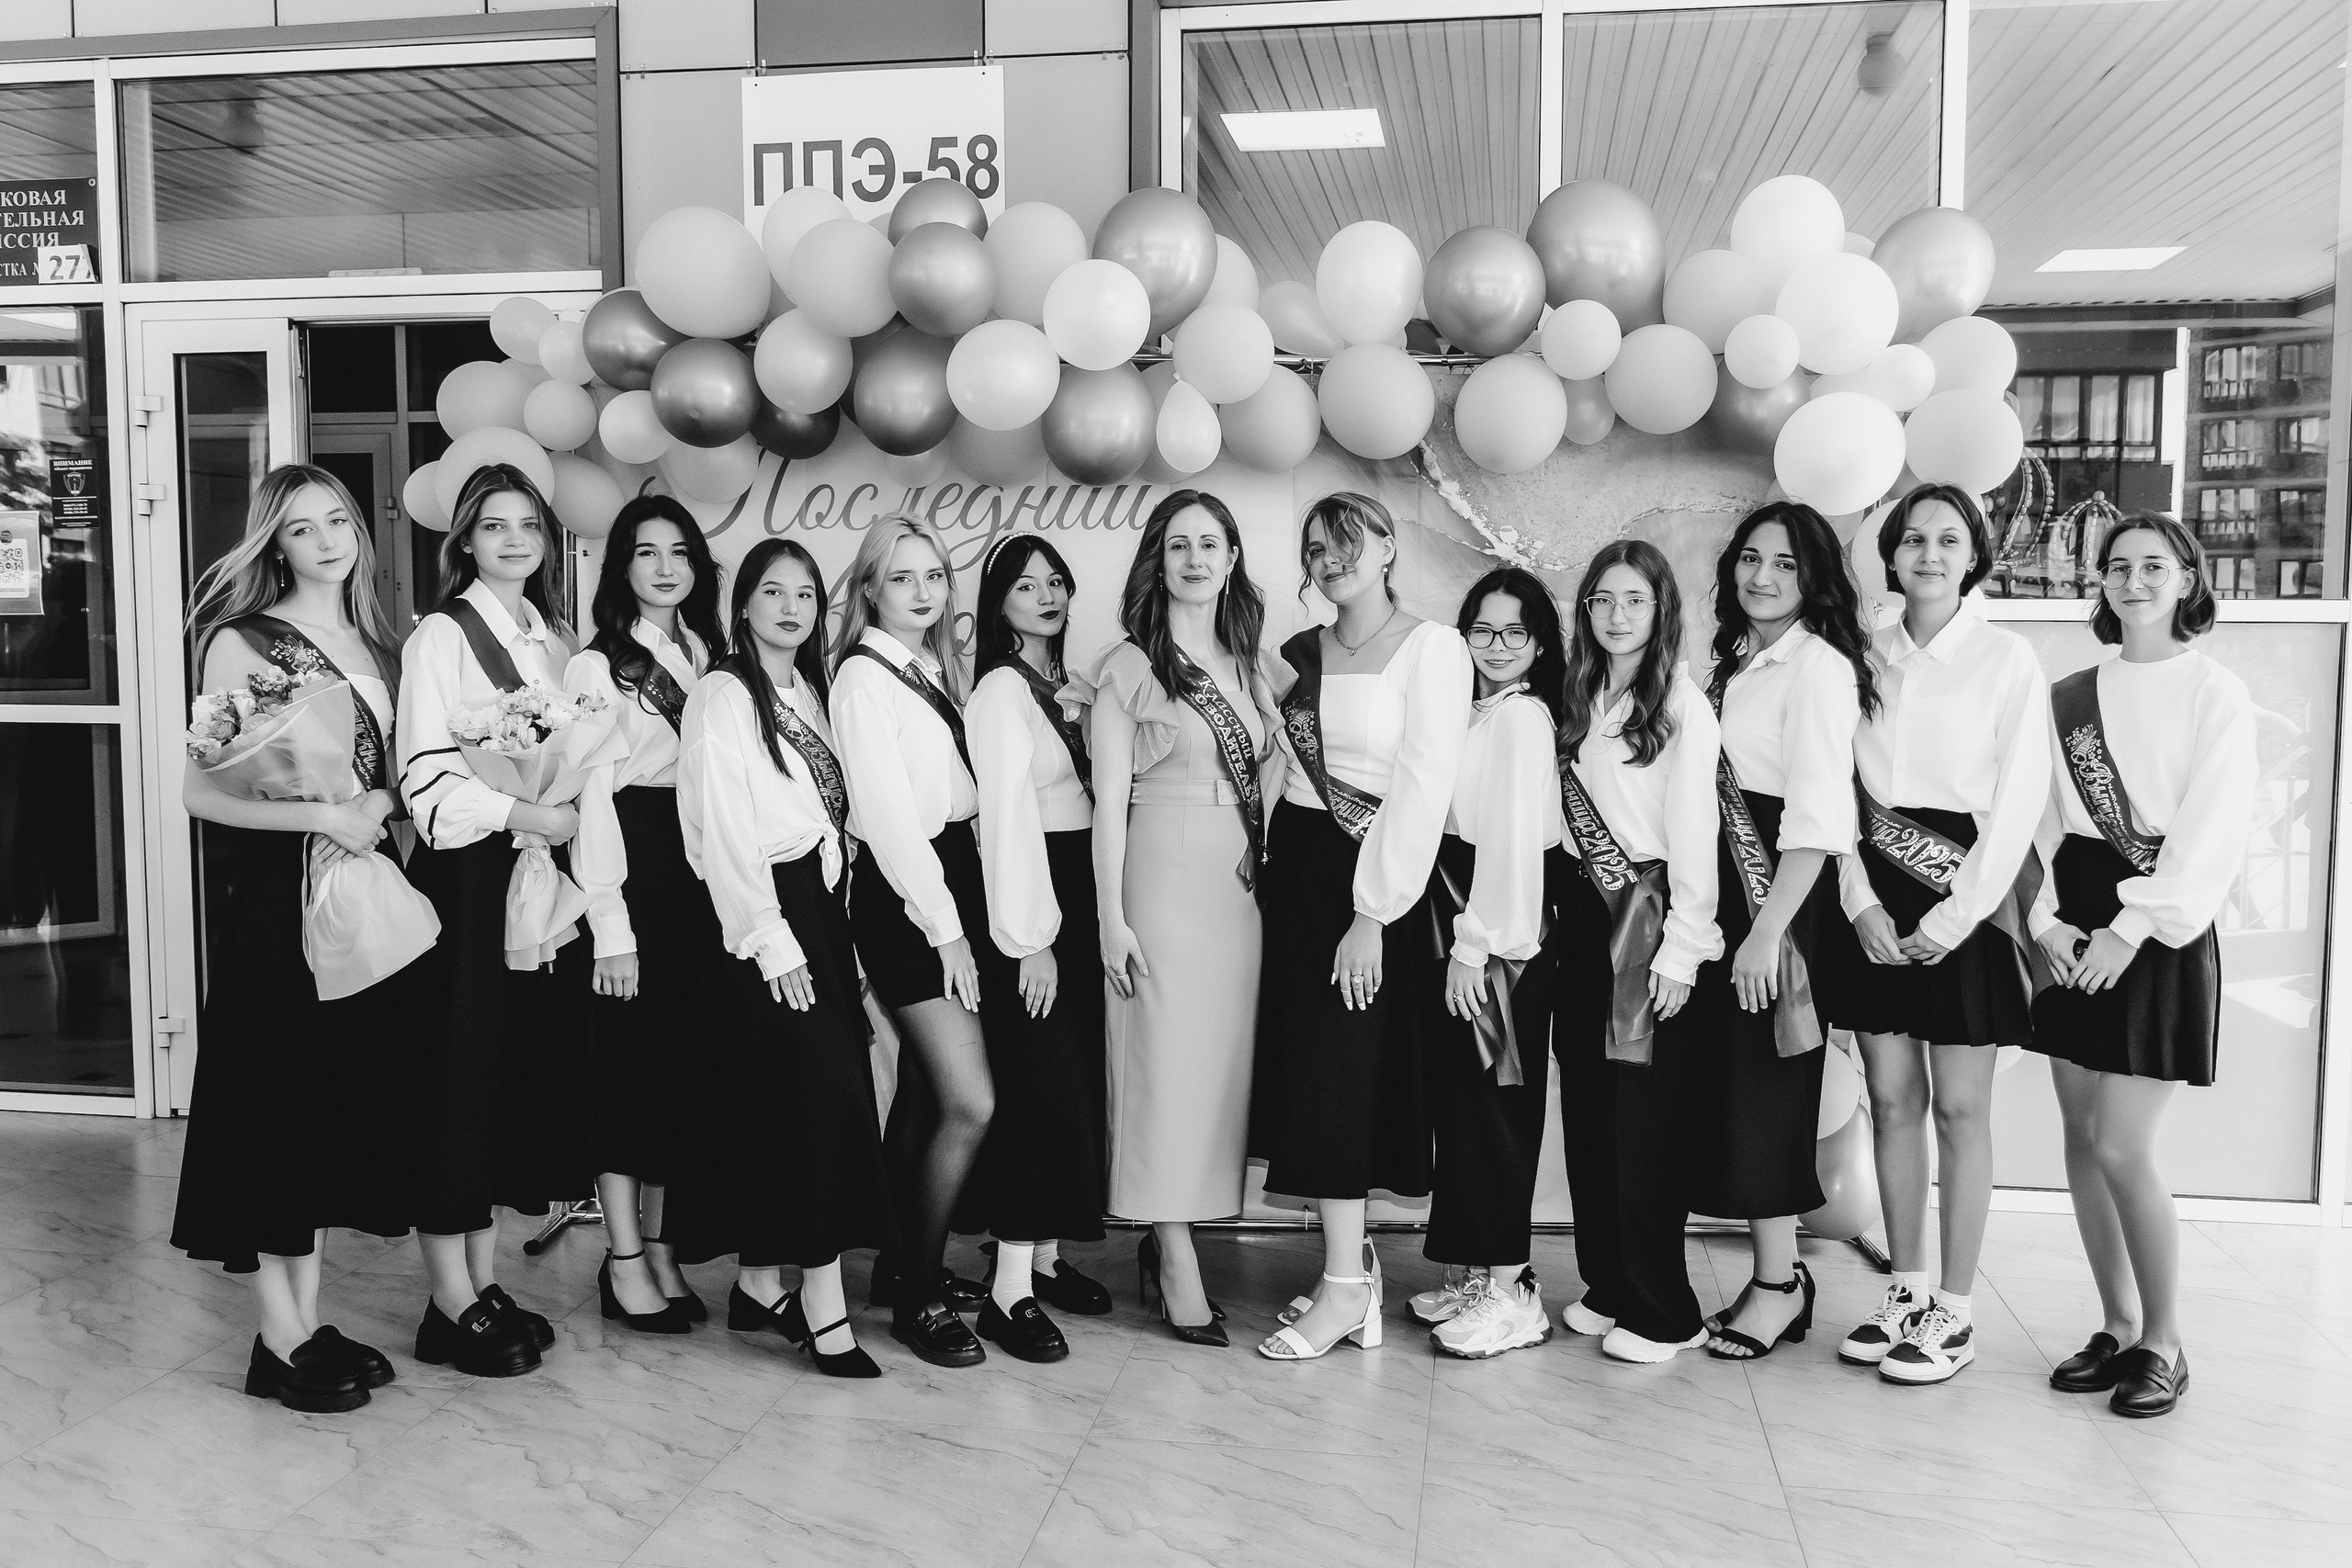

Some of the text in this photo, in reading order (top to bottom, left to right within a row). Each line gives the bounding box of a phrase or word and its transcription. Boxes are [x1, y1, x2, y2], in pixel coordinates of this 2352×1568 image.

[753, 133, 1000, 206] ППЭ-58
[0, 210, 85, 228] ЕЛЬНАЯ
[0, 232, 60, 249] ССИЯ
[1191, 690, 1255, 799] ОВОДИТЕЛЬ
[1197, 675, 1255, 760] Классный
[1579, 829, 1639, 891] 2025
[1885, 828, 1966, 884] 2025
